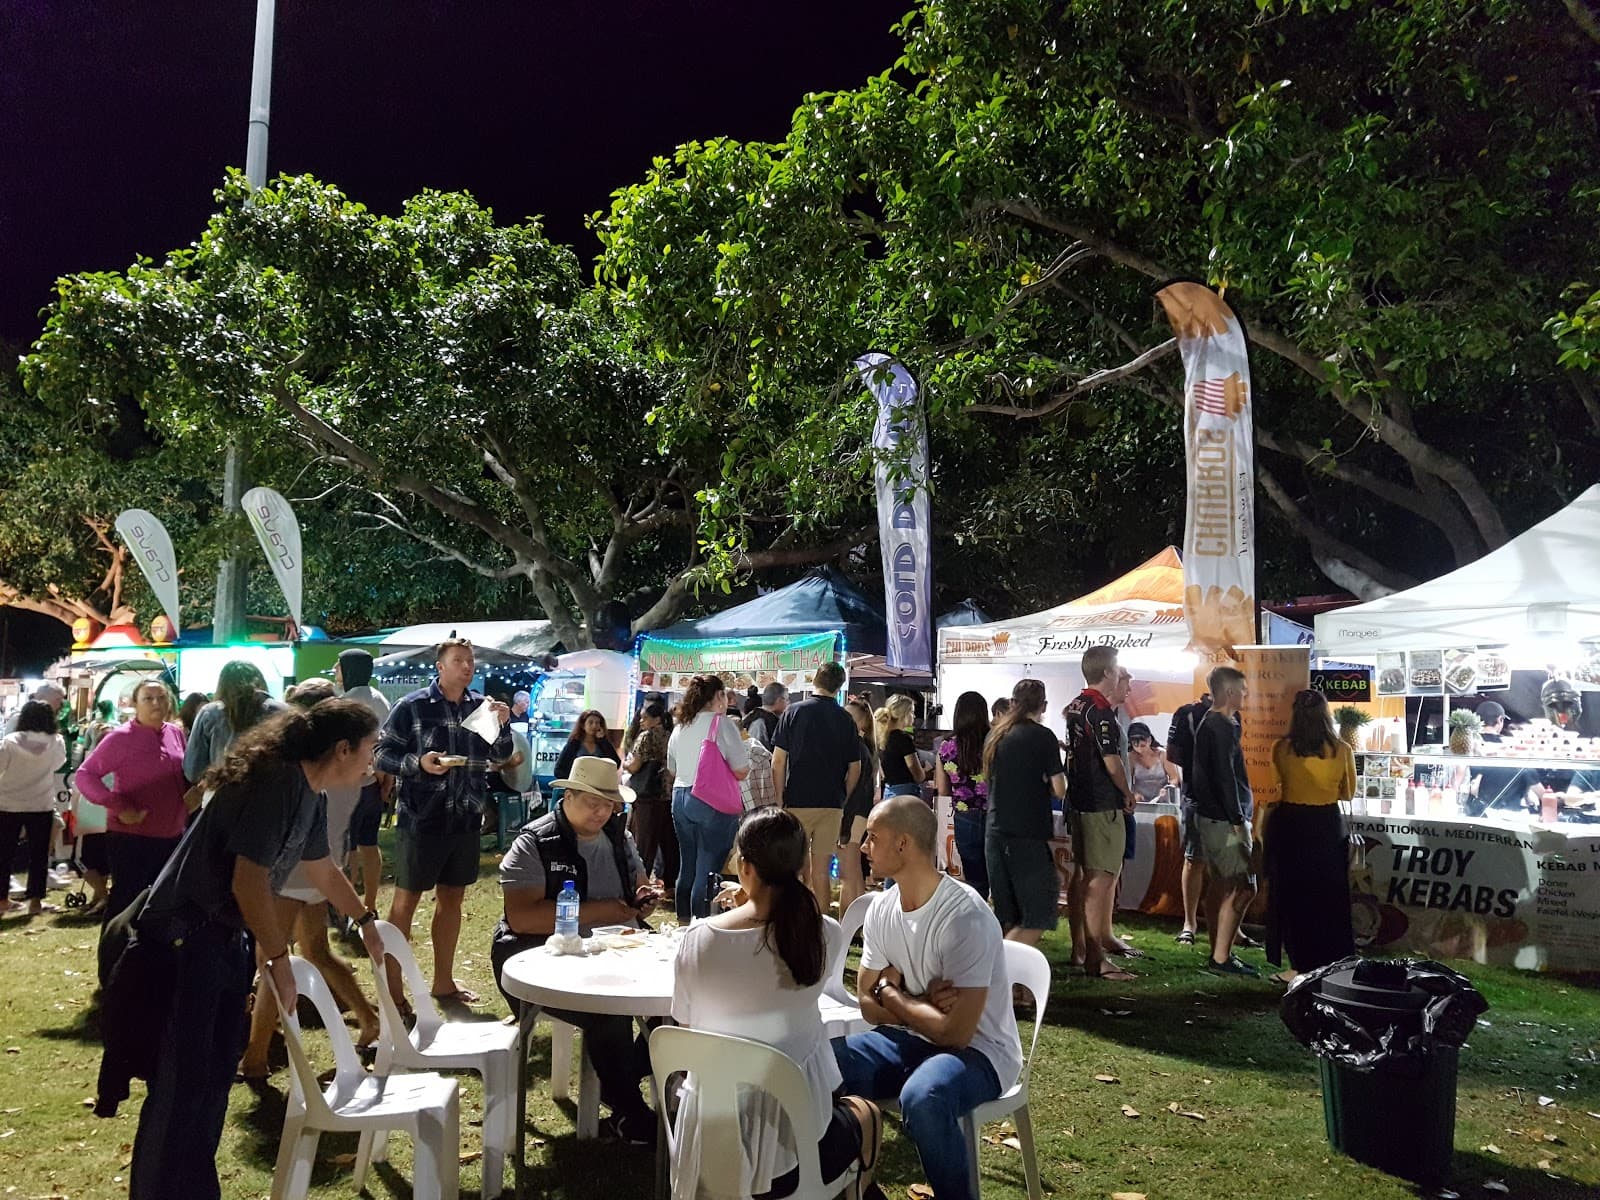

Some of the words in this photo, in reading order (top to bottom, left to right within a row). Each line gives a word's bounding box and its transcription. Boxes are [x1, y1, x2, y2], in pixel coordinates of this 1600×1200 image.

[1035, 634, 1096, 655] Freshly
[1099, 632, 1153, 649] Baked
[709, 650, 784, 670] AUTHENTIC
[1326, 679, 1367, 690] KEBAB
[1349, 821, 1440, 837] TRADITIONAL
[1444, 828, 1535, 850] MEDITERRAN
[1390, 843, 1476, 878] TROY
[1536, 861, 1586, 872] KEBAB
[1538, 878, 1569, 888] Doner
[1386, 876, 1520, 919] KEBABS
[1537, 887, 1576, 898] Chicken
[1537, 896, 1568, 907] Mixed
